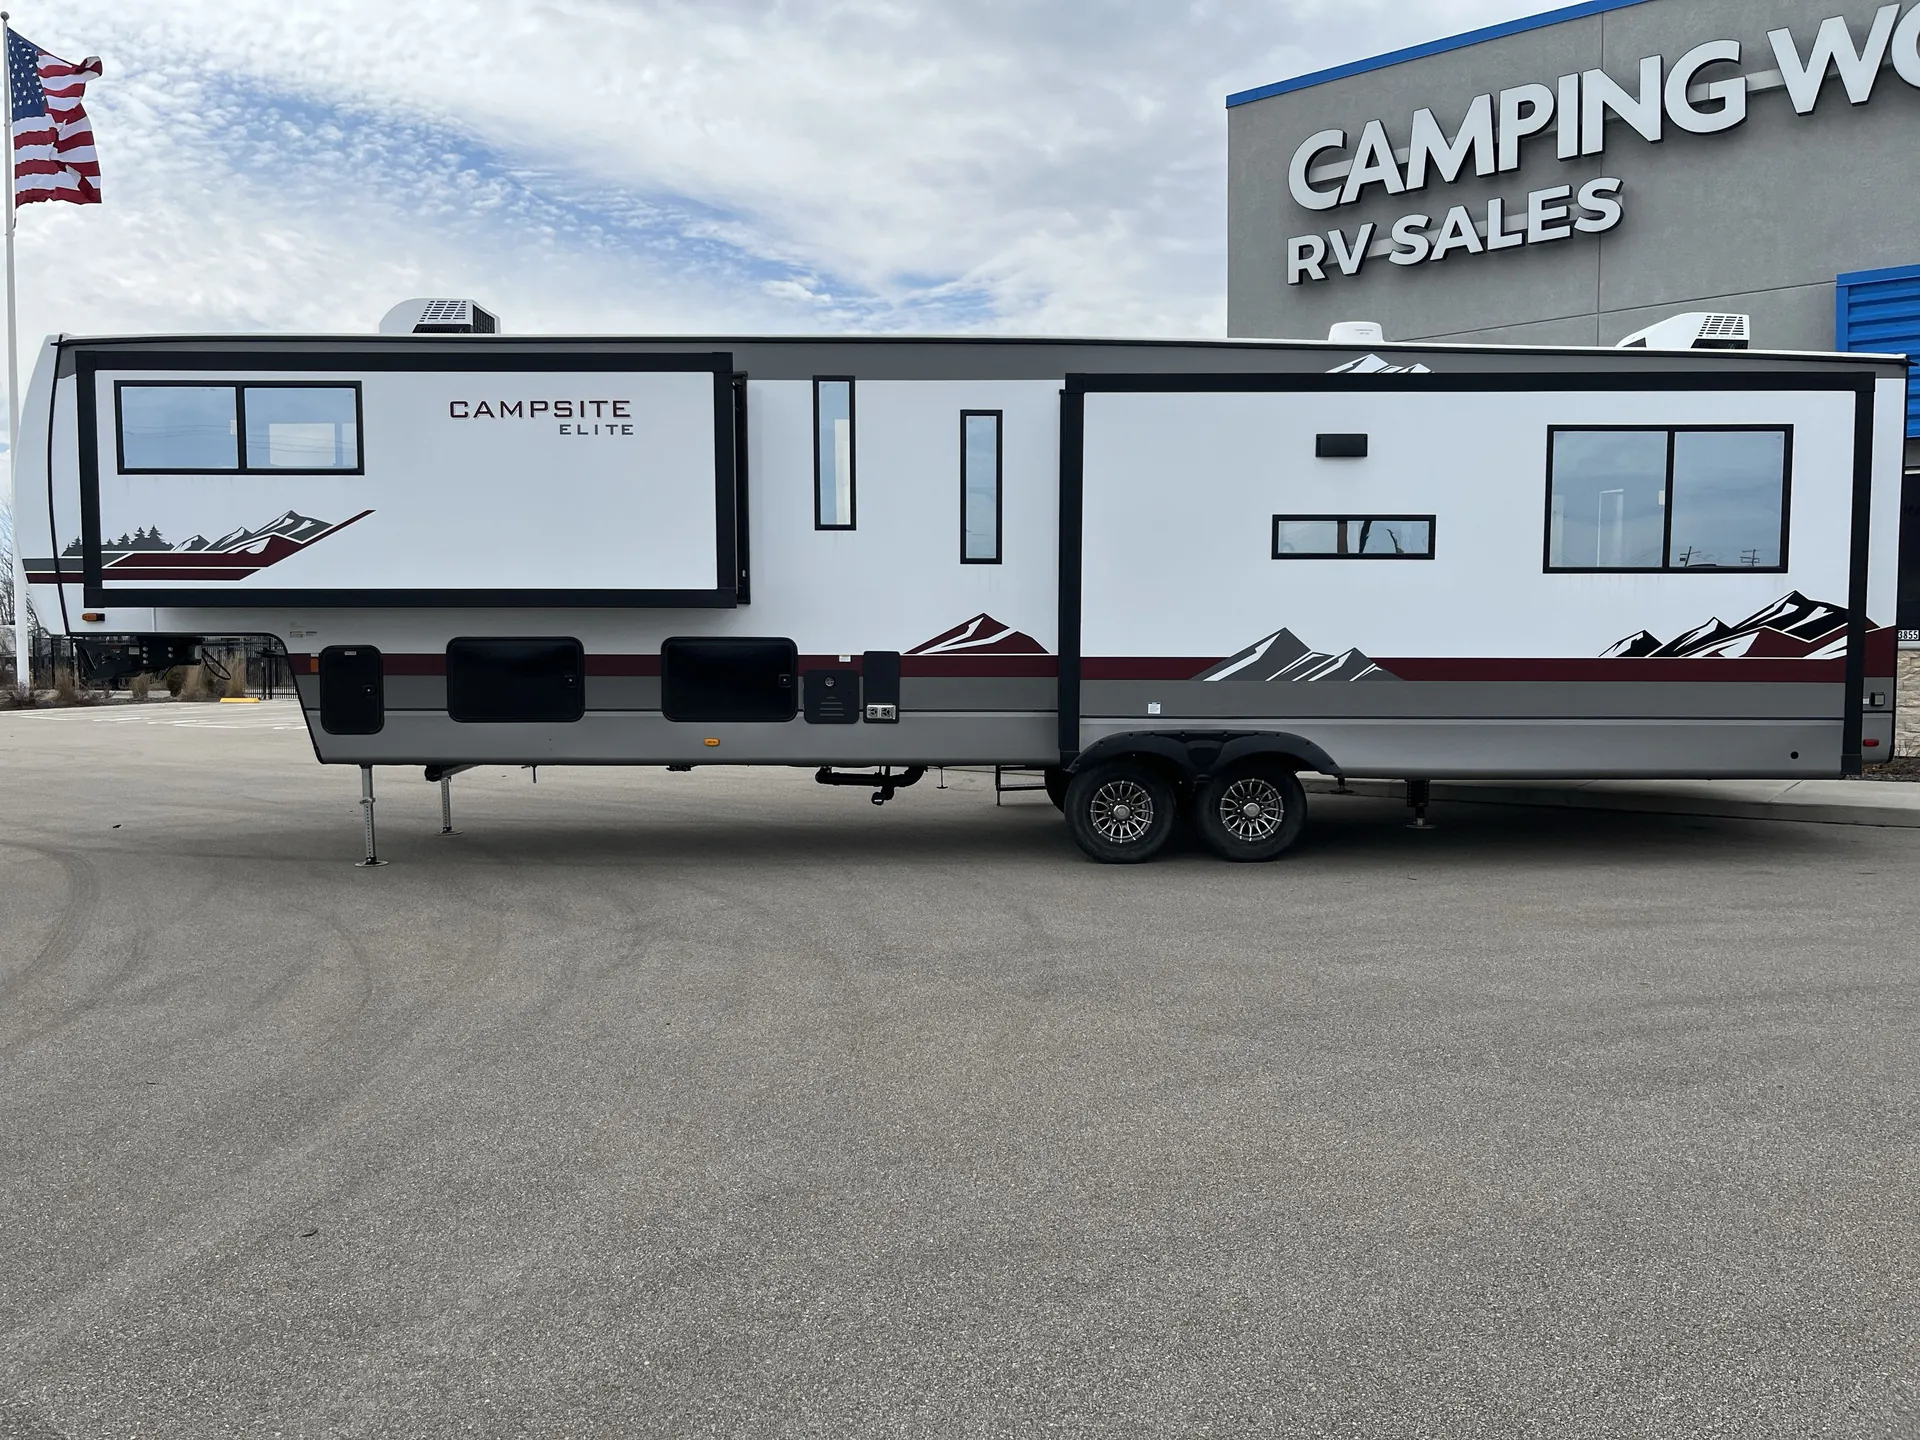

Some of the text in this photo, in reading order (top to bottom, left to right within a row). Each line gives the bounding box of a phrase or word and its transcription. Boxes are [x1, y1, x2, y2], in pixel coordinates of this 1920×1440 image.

[1287, 39, 1747, 211] CAMPING
[1287, 177, 1625, 285] RV SALES
[449, 400, 632, 419] CAMPSITE
[559, 424, 634, 436] ELITE
[1898, 630, 1918, 640] 3855
